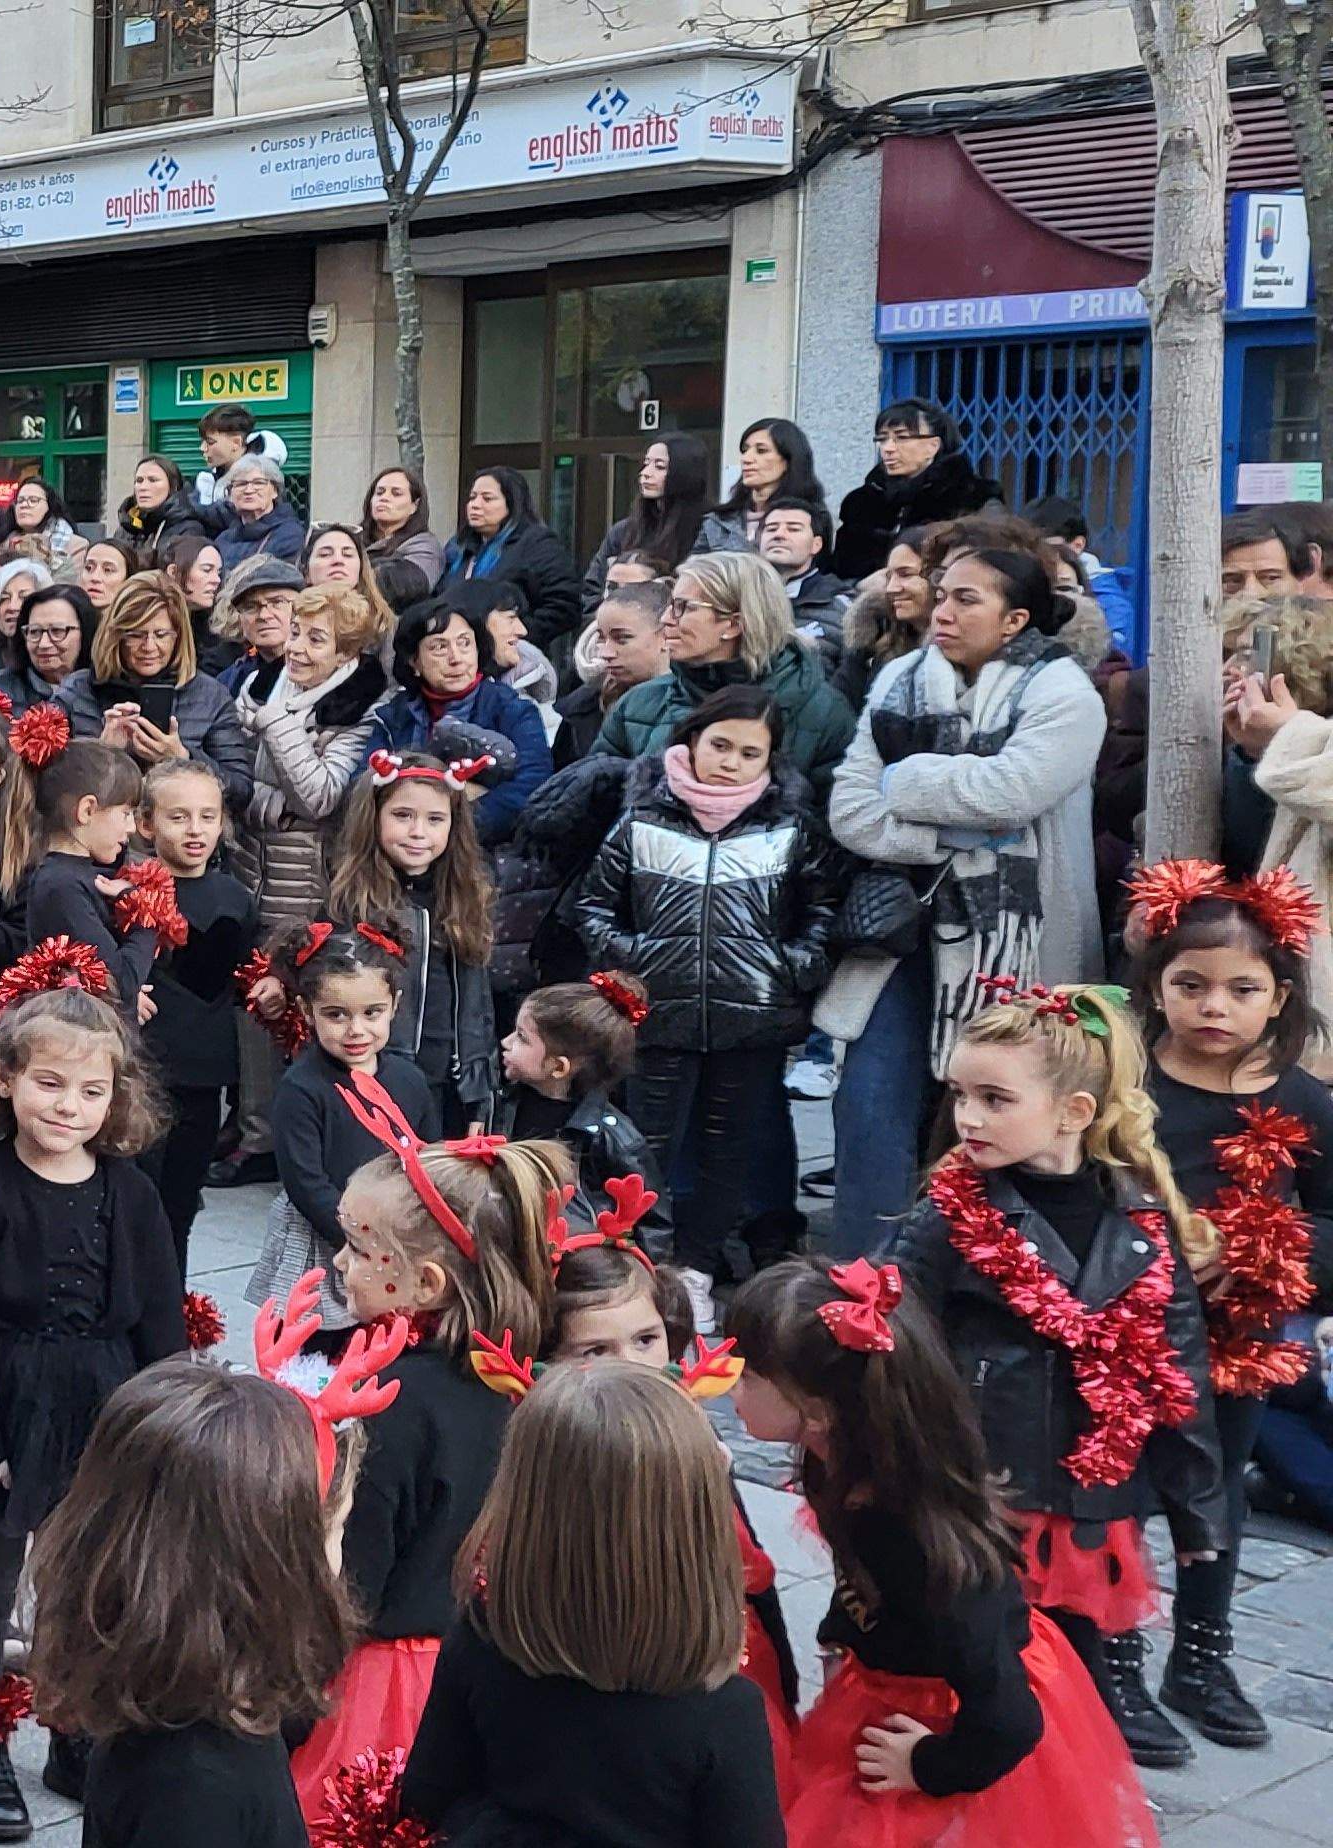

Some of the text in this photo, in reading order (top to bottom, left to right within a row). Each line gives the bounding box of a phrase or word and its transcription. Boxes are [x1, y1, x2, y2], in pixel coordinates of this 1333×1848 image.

[260, 135, 306, 153] Cursos
[309, 135, 317, 149] y
[321, 124, 380, 144] Práctica
[389, 112, 456, 134] Lorale
[529, 113, 679, 173] english maths
[709, 112, 784, 144] english maths
[260, 160, 271, 175] el
[275, 152, 340, 172] extranjero
[345, 142, 397, 163] durae
[455, 131, 482, 147] año
[20, 178, 36, 190] los
[38, 174, 46, 187] 4
[48, 172, 75, 186] años
[37, 190, 74, 206] C1-C2)
[106, 178, 215, 228] english maths
[893, 288, 1150, 331] LOTERIA Y PRIM
[209, 367, 280, 395] ONCE
[643, 403, 656, 427] 6
